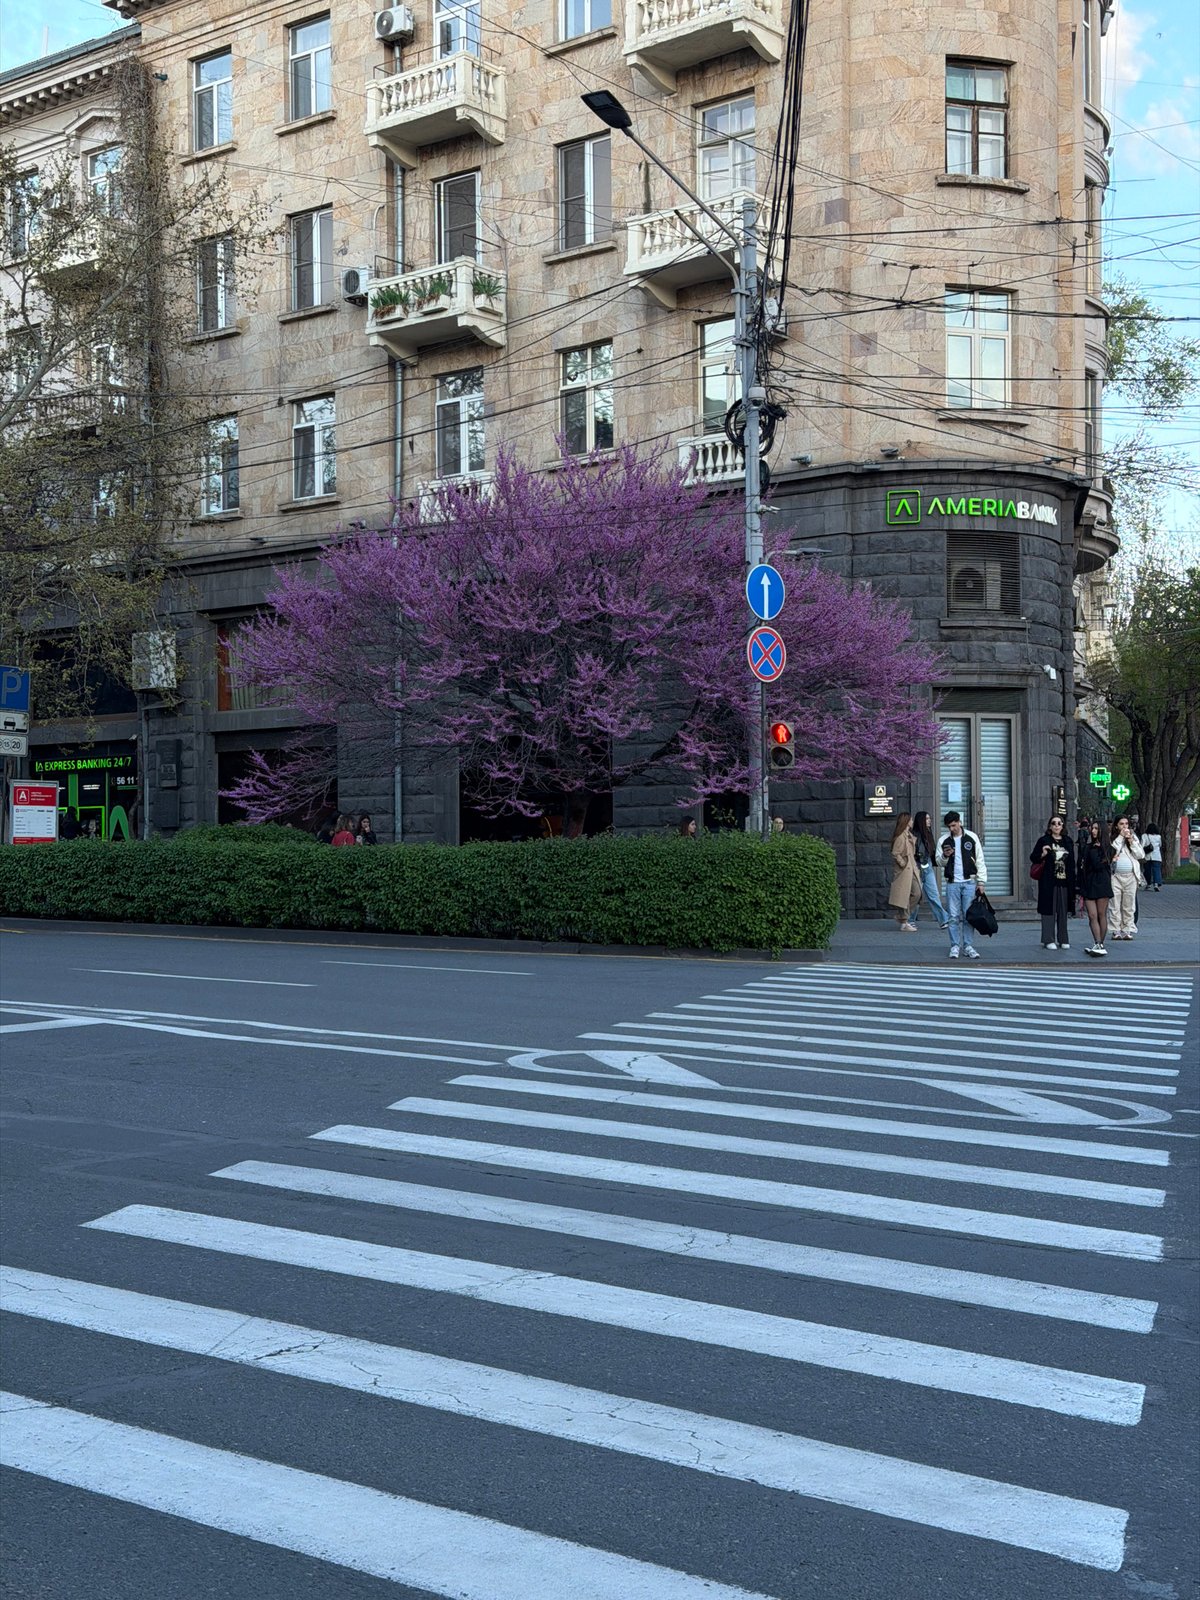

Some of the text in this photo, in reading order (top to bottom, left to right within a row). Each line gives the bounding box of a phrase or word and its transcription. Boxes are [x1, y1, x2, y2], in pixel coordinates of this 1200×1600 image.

[1, 671, 22, 704] P
[12, 741, 20, 750] 20
[44, 757, 132, 771] EXPRESS BANKING 24/7
[117, 776, 124, 785] 56
[127, 776, 135, 784] 11
